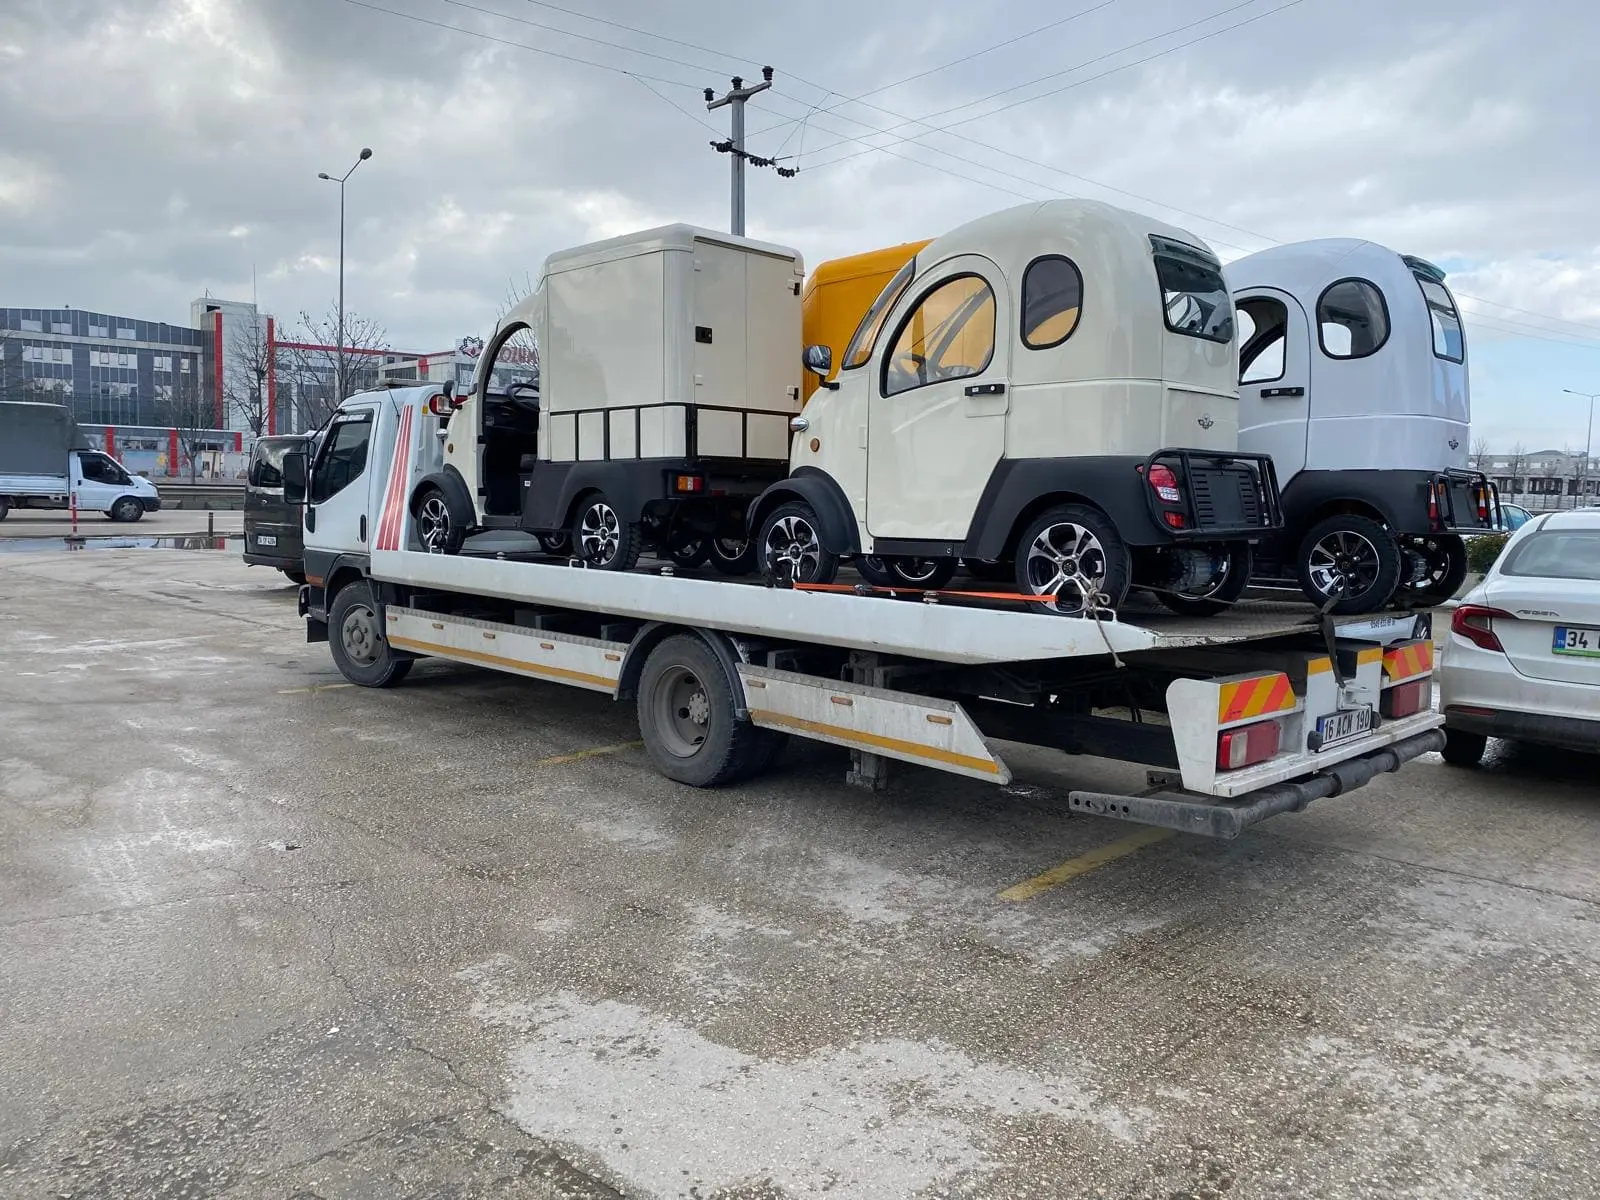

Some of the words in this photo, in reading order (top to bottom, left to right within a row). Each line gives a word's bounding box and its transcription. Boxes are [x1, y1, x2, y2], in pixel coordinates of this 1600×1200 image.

[1567, 631, 1588, 649] 34
[1324, 719, 1334, 741] 16
[1356, 708, 1370, 731] 190
